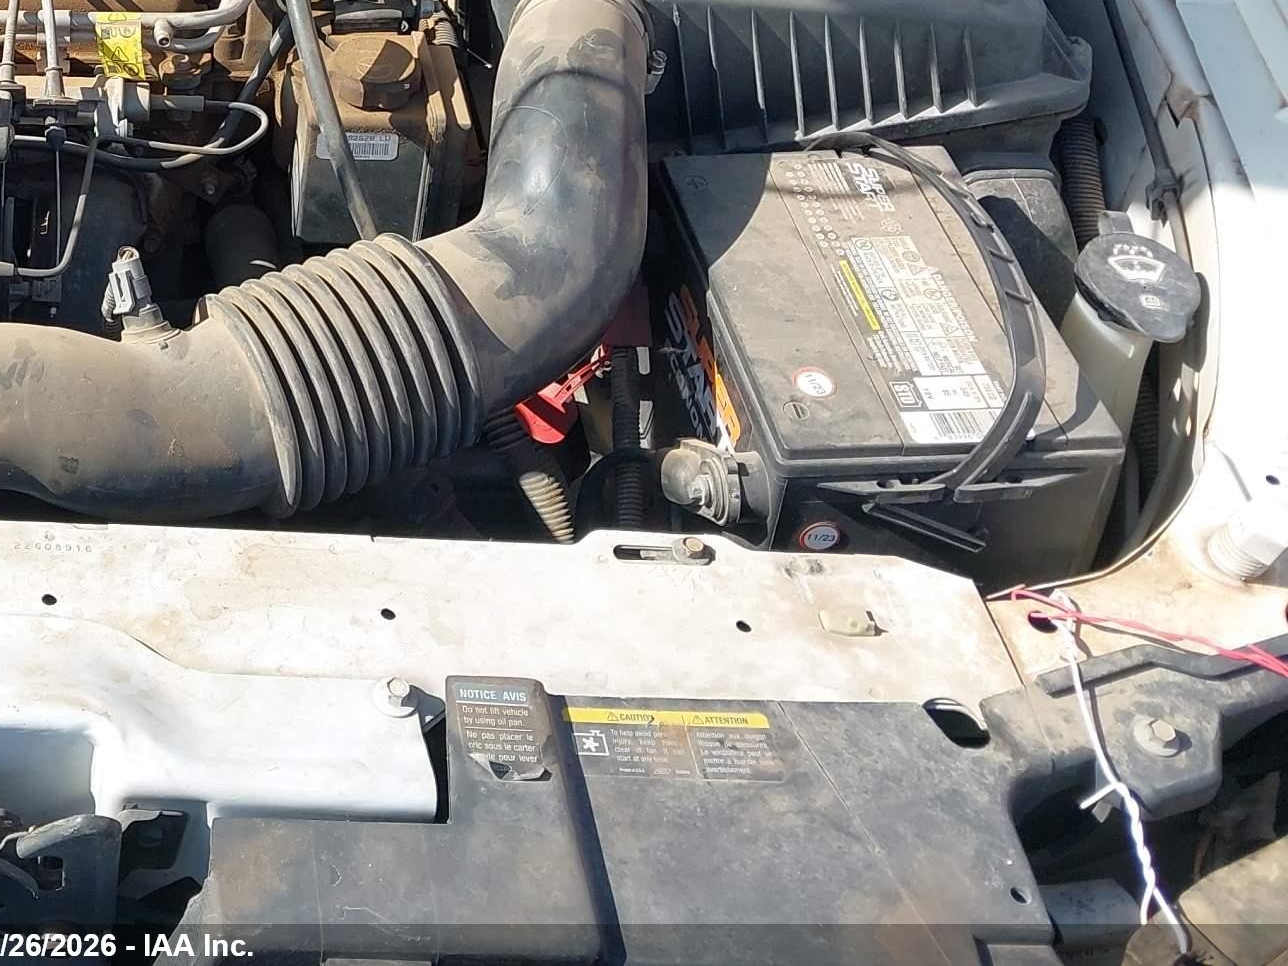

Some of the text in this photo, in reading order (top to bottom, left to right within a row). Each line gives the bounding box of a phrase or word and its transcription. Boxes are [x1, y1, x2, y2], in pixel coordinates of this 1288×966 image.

[845, 161, 880, 208] START
[865, 167, 896, 212] SUPER
[680, 283, 741, 450] SUPER
[804, 374, 826, 395] 11/23
[892, 384, 915, 406] STD
[807, 534, 835, 542] 11/23
[459, 688, 527, 702] NOTICE AVIS
[462, 705, 473, 714] Do
[489, 707, 500, 715] lift
[503, 708, 529, 717] vehicle
[464, 716, 526, 727] by using oil pan.
[704, 716, 749, 725] ATTENTION
[466, 730, 534, 742] Ne pas placer le
[618, 730, 633, 738] help
[484, 743, 503, 751] sous
[504, 743, 512, 751] le
[513, 744, 536, 752] carter
[498, 754, 517, 763] pour
[519, 754, 538, 763] lever
[616, 754, 632, 762] start
[641, 755, 653, 763] any
